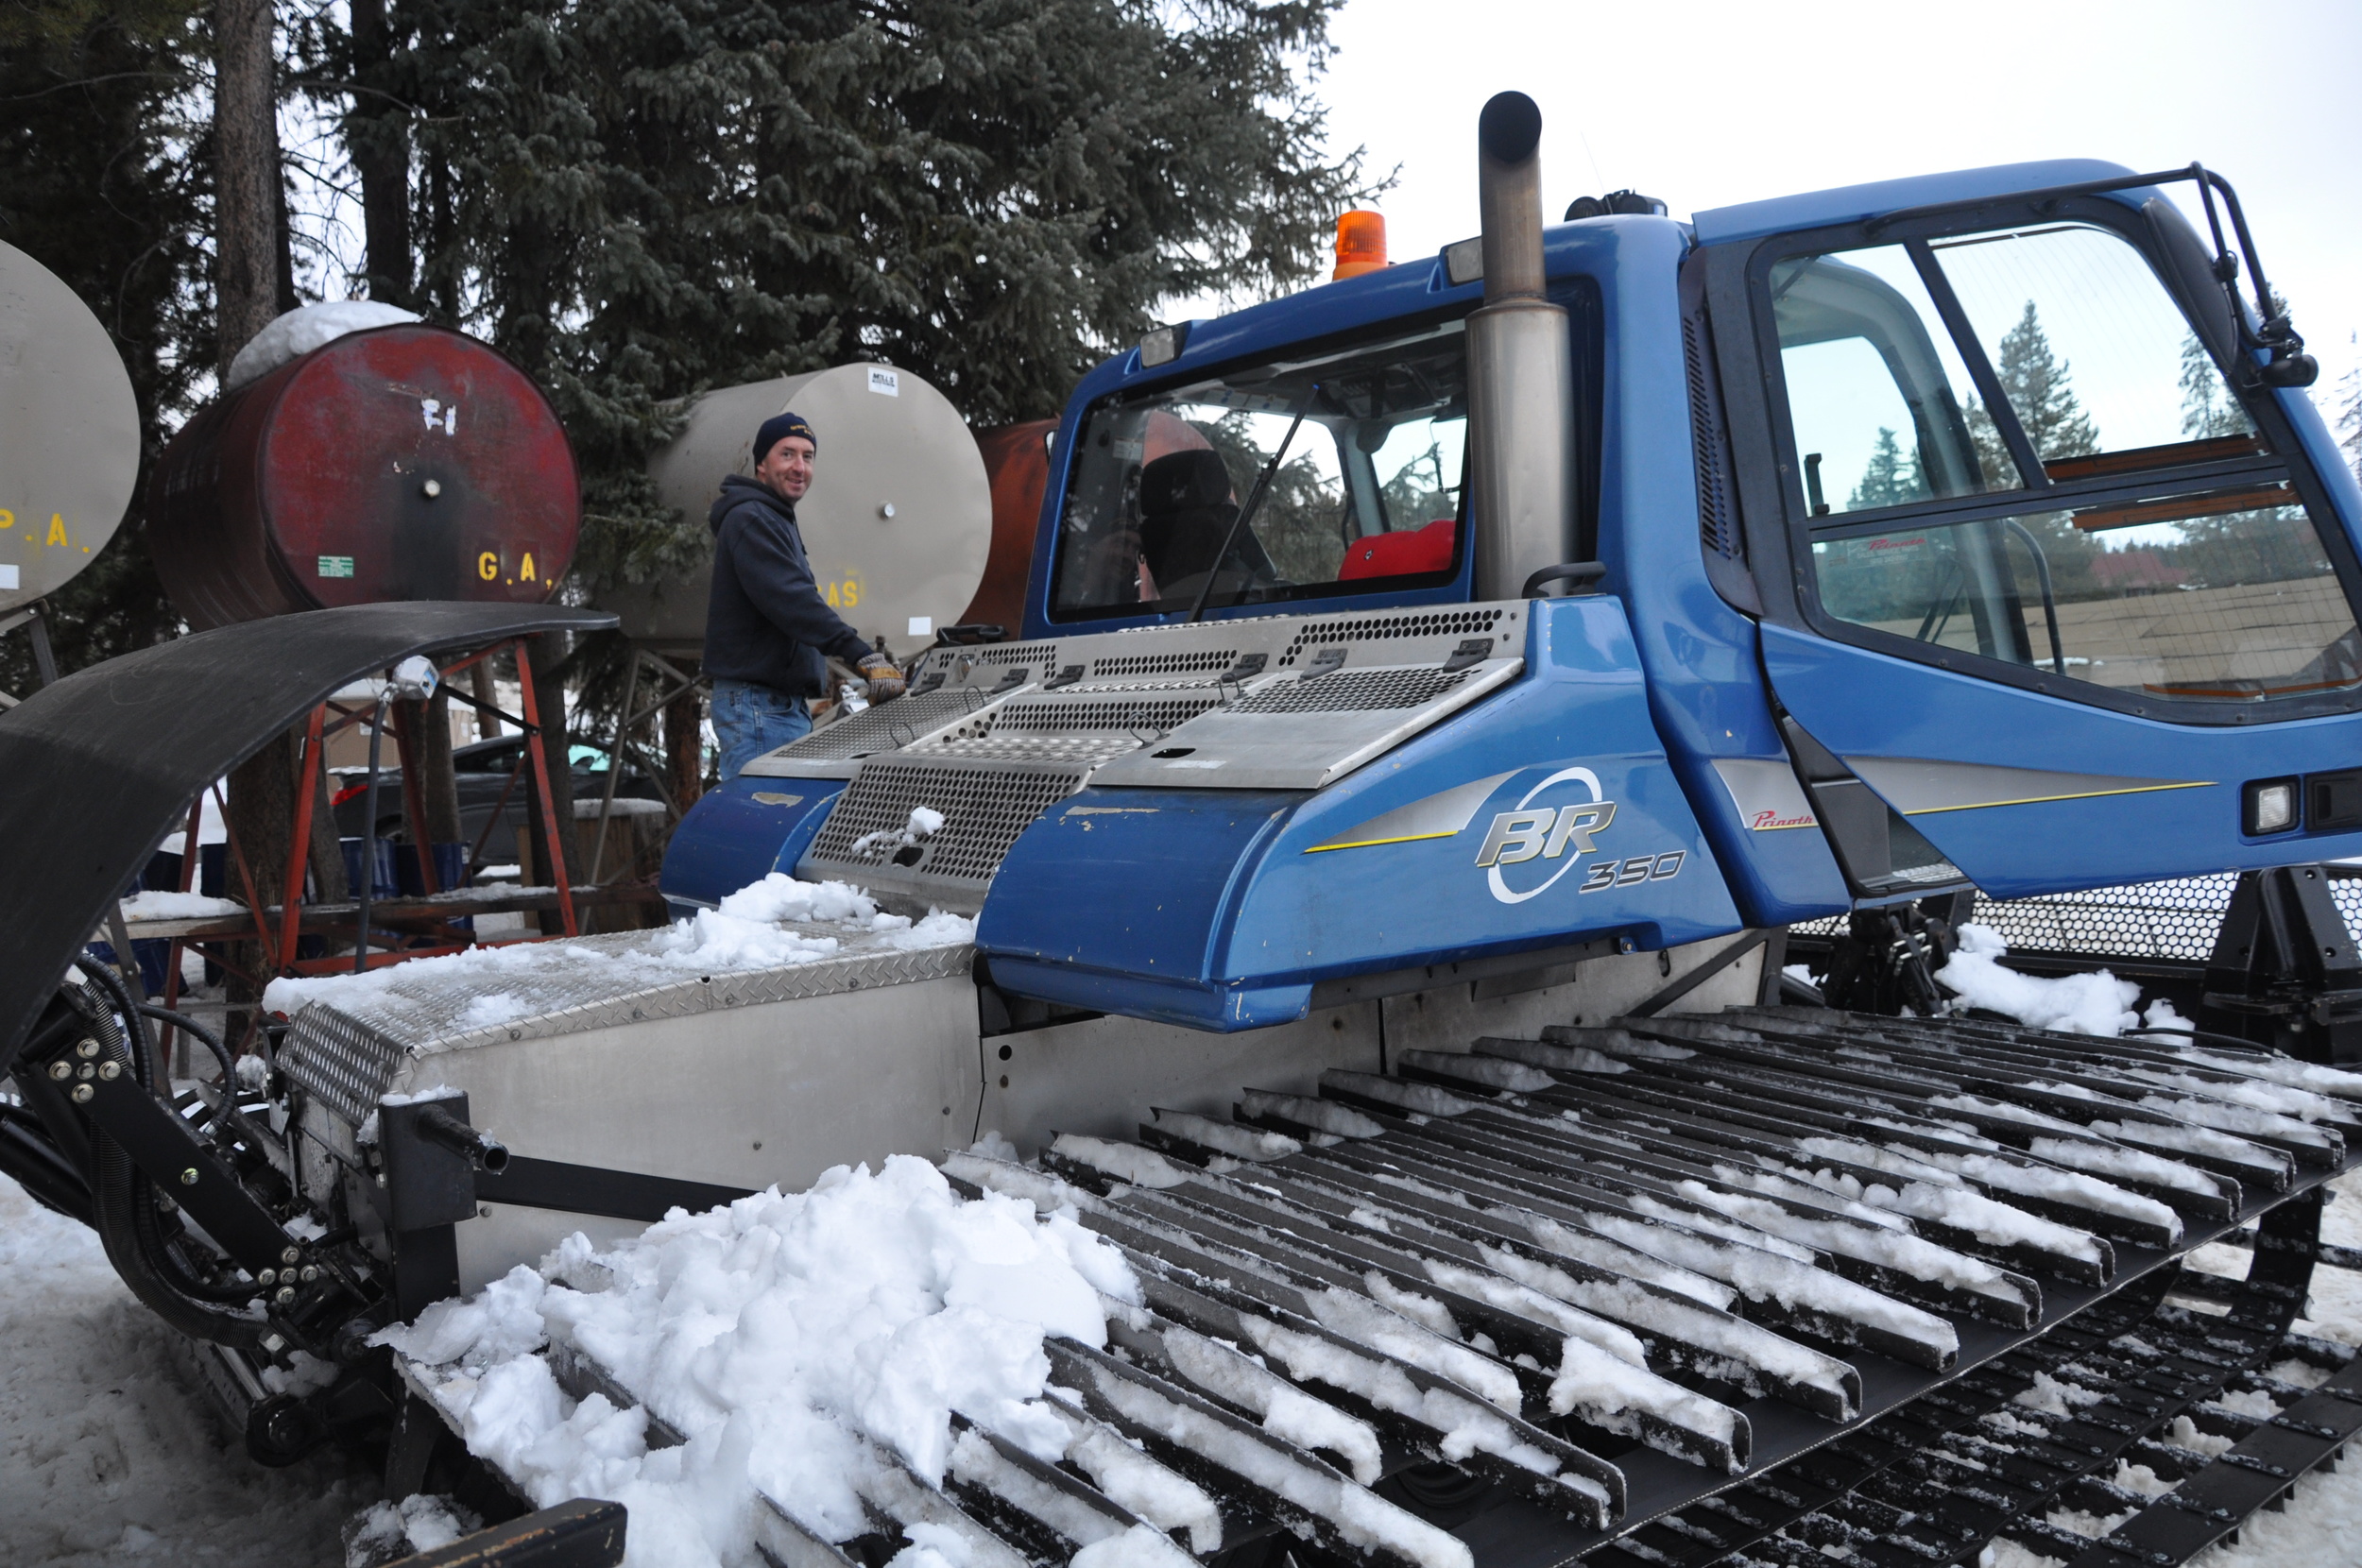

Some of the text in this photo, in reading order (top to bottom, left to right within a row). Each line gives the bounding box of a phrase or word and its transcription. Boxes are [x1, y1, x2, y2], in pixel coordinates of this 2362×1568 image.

[478, 551, 553, 588] G.A.
[817, 580, 859, 608] AS
[1474, 801, 1617, 867] BR
[1752, 810, 1813, 827] Prinoth
[1578, 849, 1686, 895] 350
